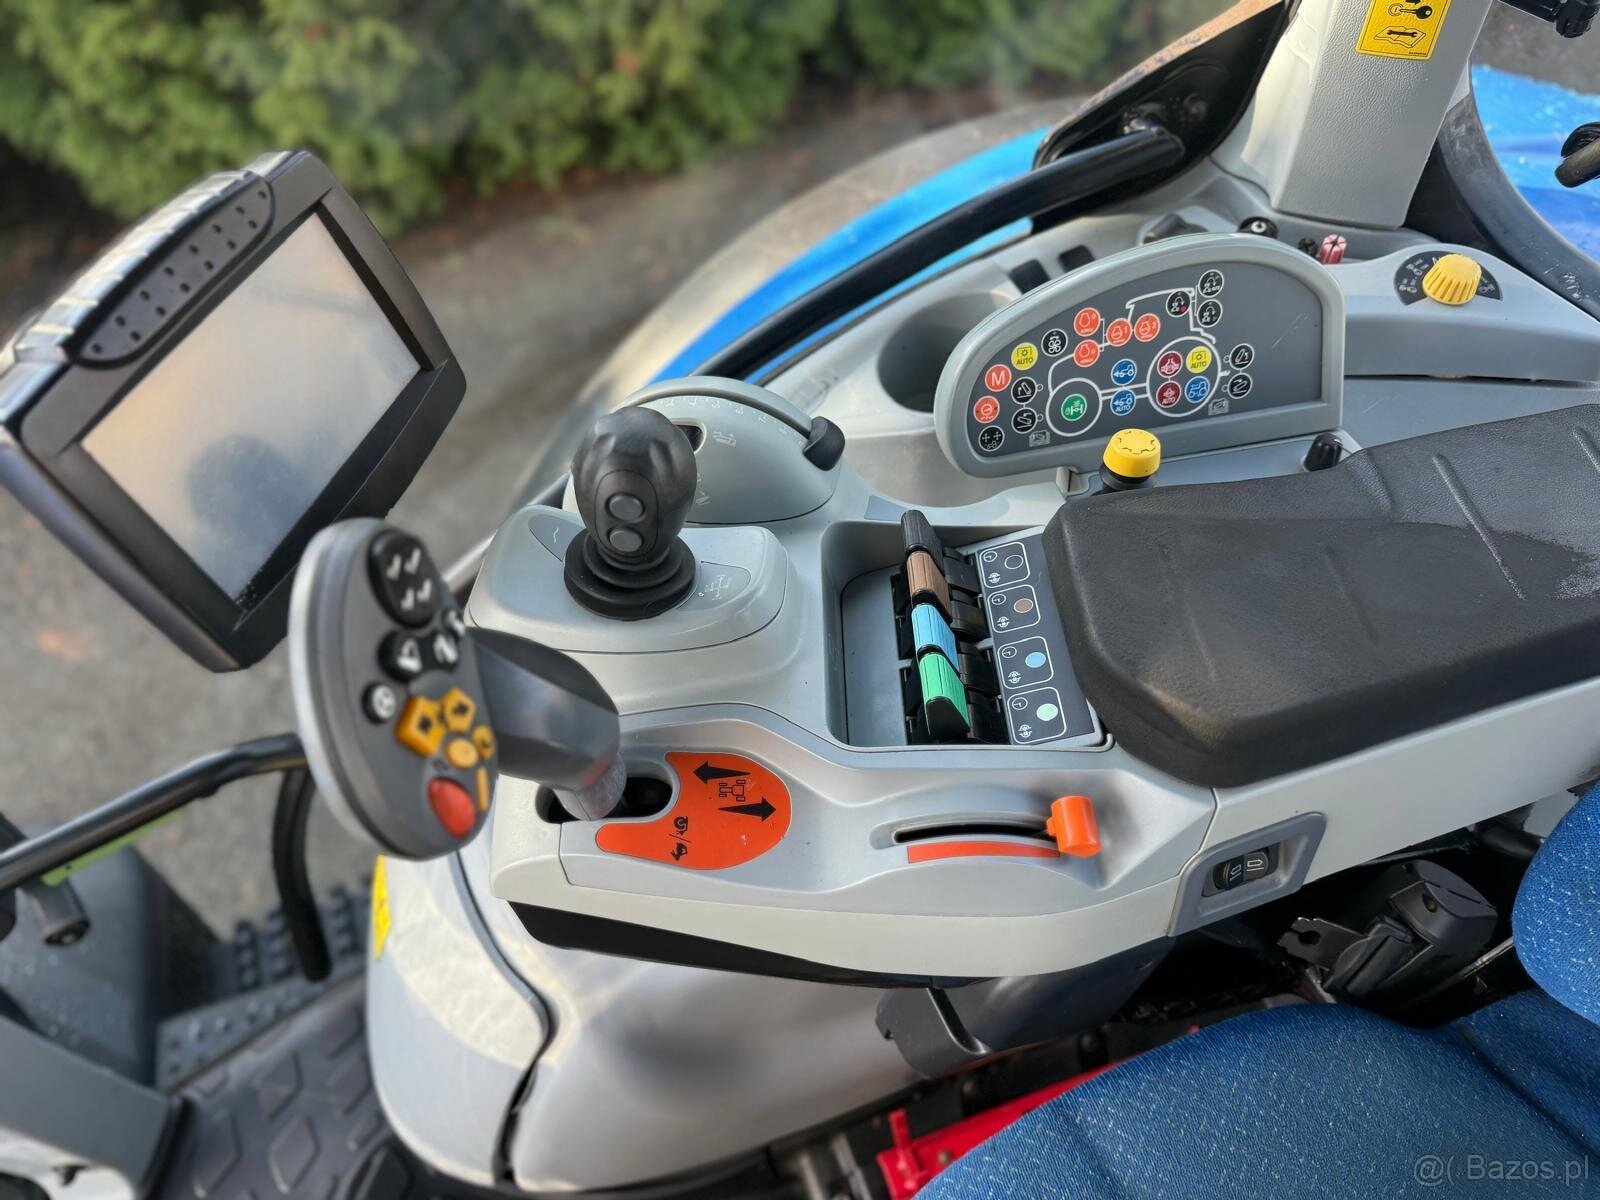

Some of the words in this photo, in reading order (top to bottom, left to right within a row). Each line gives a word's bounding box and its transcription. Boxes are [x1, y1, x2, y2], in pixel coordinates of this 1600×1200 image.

[1016, 357, 1034, 365] AUTO
[1191, 361, 1207, 369] AUTO
[991, 371, 1005, 386] M
[1162, 397, 1176, 405] AUTO
